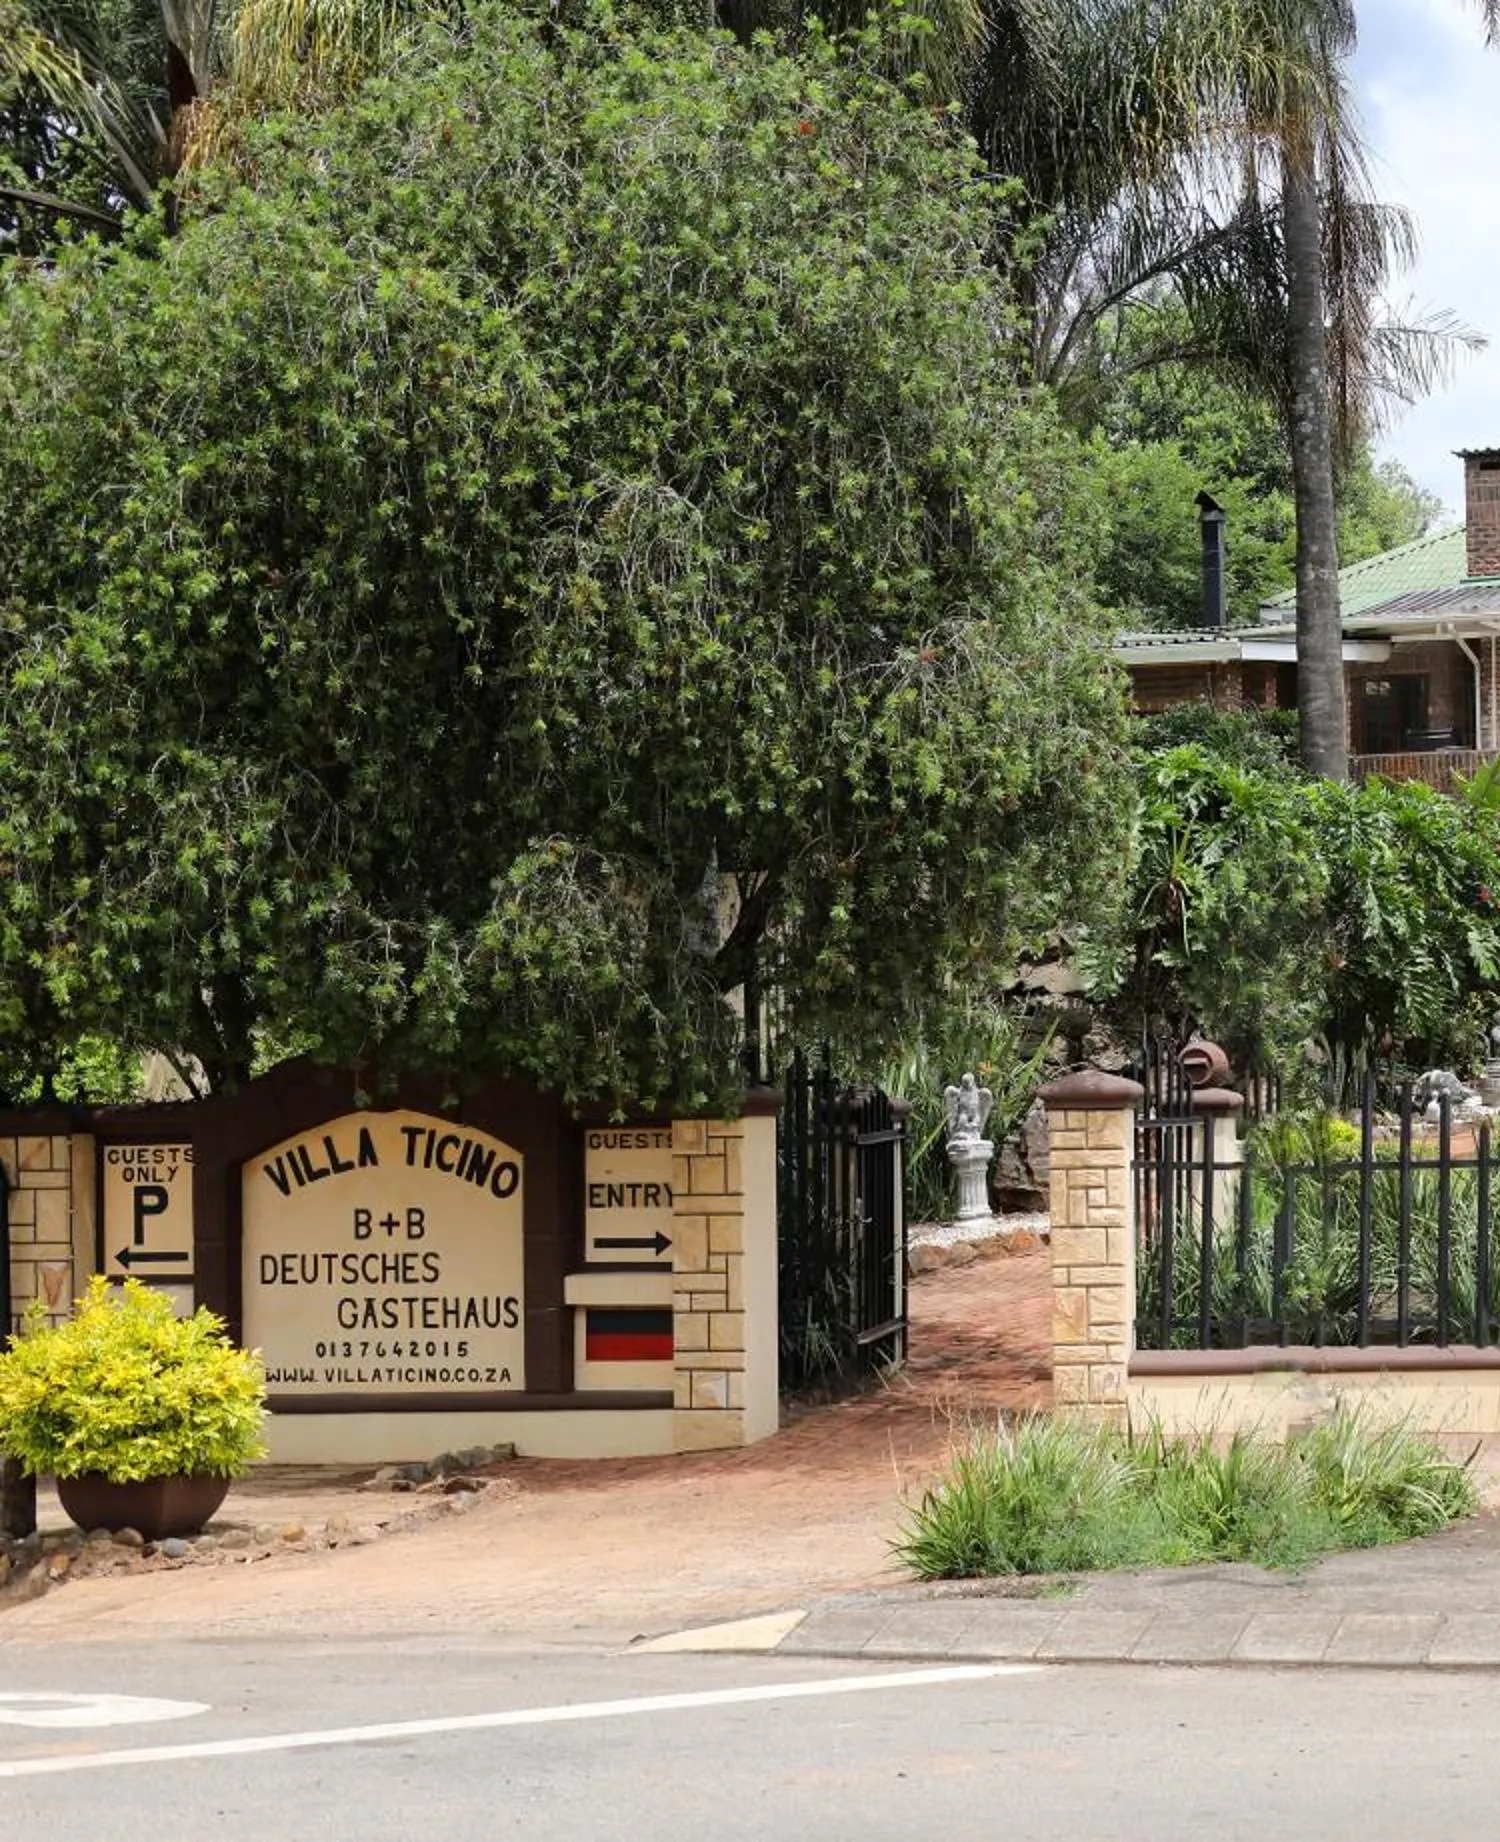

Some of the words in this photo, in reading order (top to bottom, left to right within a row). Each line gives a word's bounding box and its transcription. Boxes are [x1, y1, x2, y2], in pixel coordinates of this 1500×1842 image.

[122, 1166, 178, 1182] ONLY
[263, 1127, 378, 1196] VILLA
[401, 1126, 519, 1198] TICINO
[260, 1253, 440, 1285] DEUTSCHES
[315, 1341, 469, 1358] 0137642015
